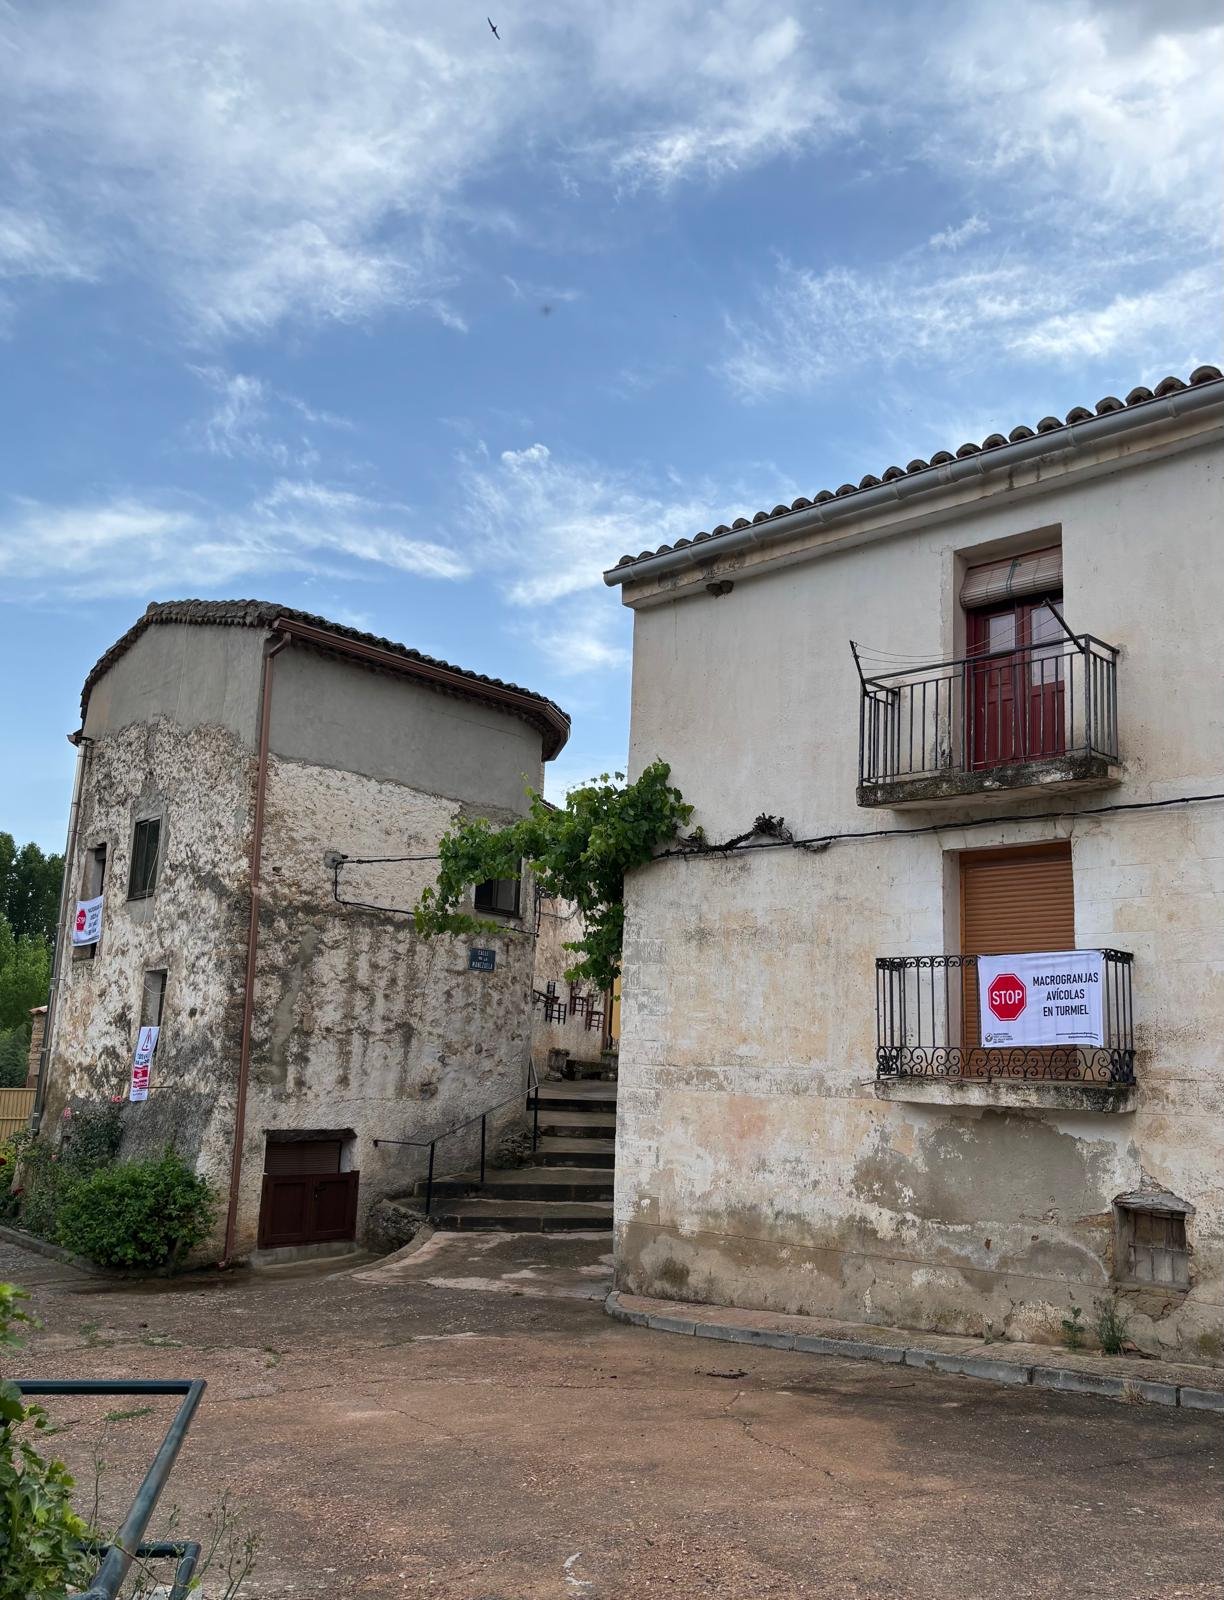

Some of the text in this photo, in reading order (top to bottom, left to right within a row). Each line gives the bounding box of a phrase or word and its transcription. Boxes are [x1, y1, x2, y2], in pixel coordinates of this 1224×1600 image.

[1032, 972, 1099, 987] MACROGRANJAS
[992, 989, 1023, 1005] STOP
[1046, 987, 1085, 1001] AVÍCOLAS
[1043, 1004, 1089, 1017] EN TURMIEL
